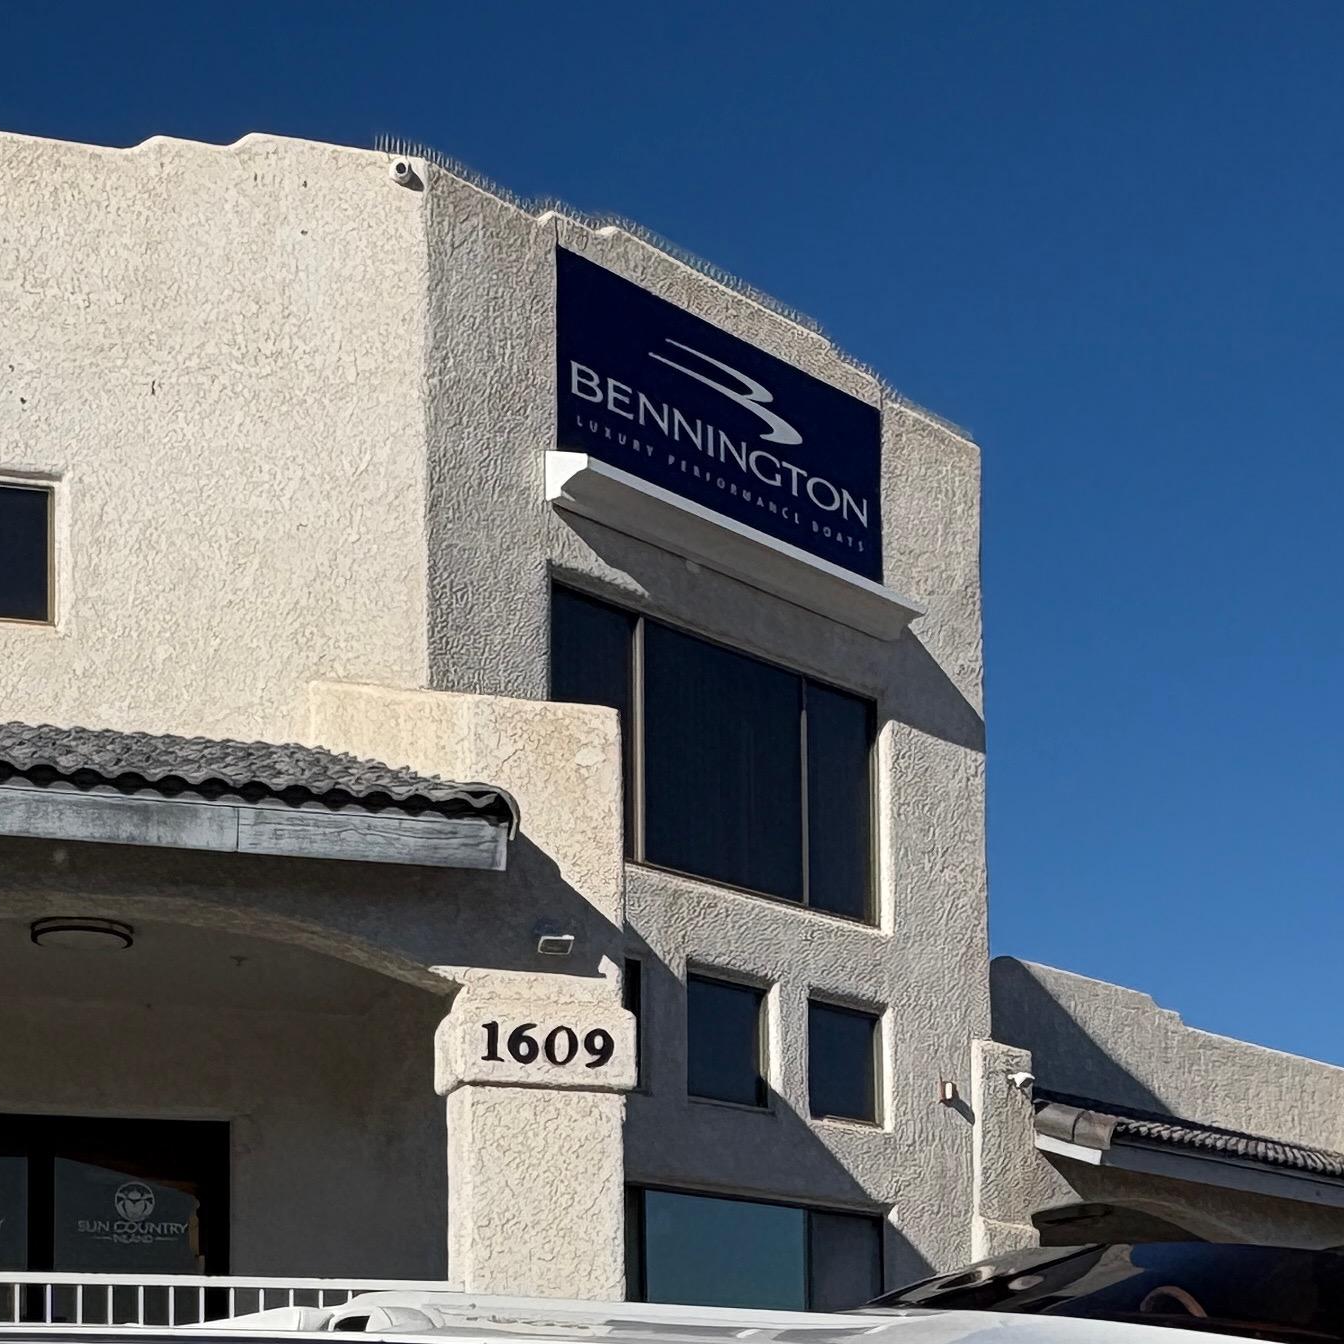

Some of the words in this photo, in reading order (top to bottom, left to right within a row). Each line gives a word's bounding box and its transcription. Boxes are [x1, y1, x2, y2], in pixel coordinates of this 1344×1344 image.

[570, 360, 869, 529] BENNINGTON
[576, 415, 654, 457] LUXURY
[667, 454, 800, 525] PERFORMANCE
[812, 520, 865, 552] BOATS
[481, 1020, 614, 1068] 1609
[77, 1220, 110, 1232] SUN
[113, 1221, 188, 1234] COUNTRY
